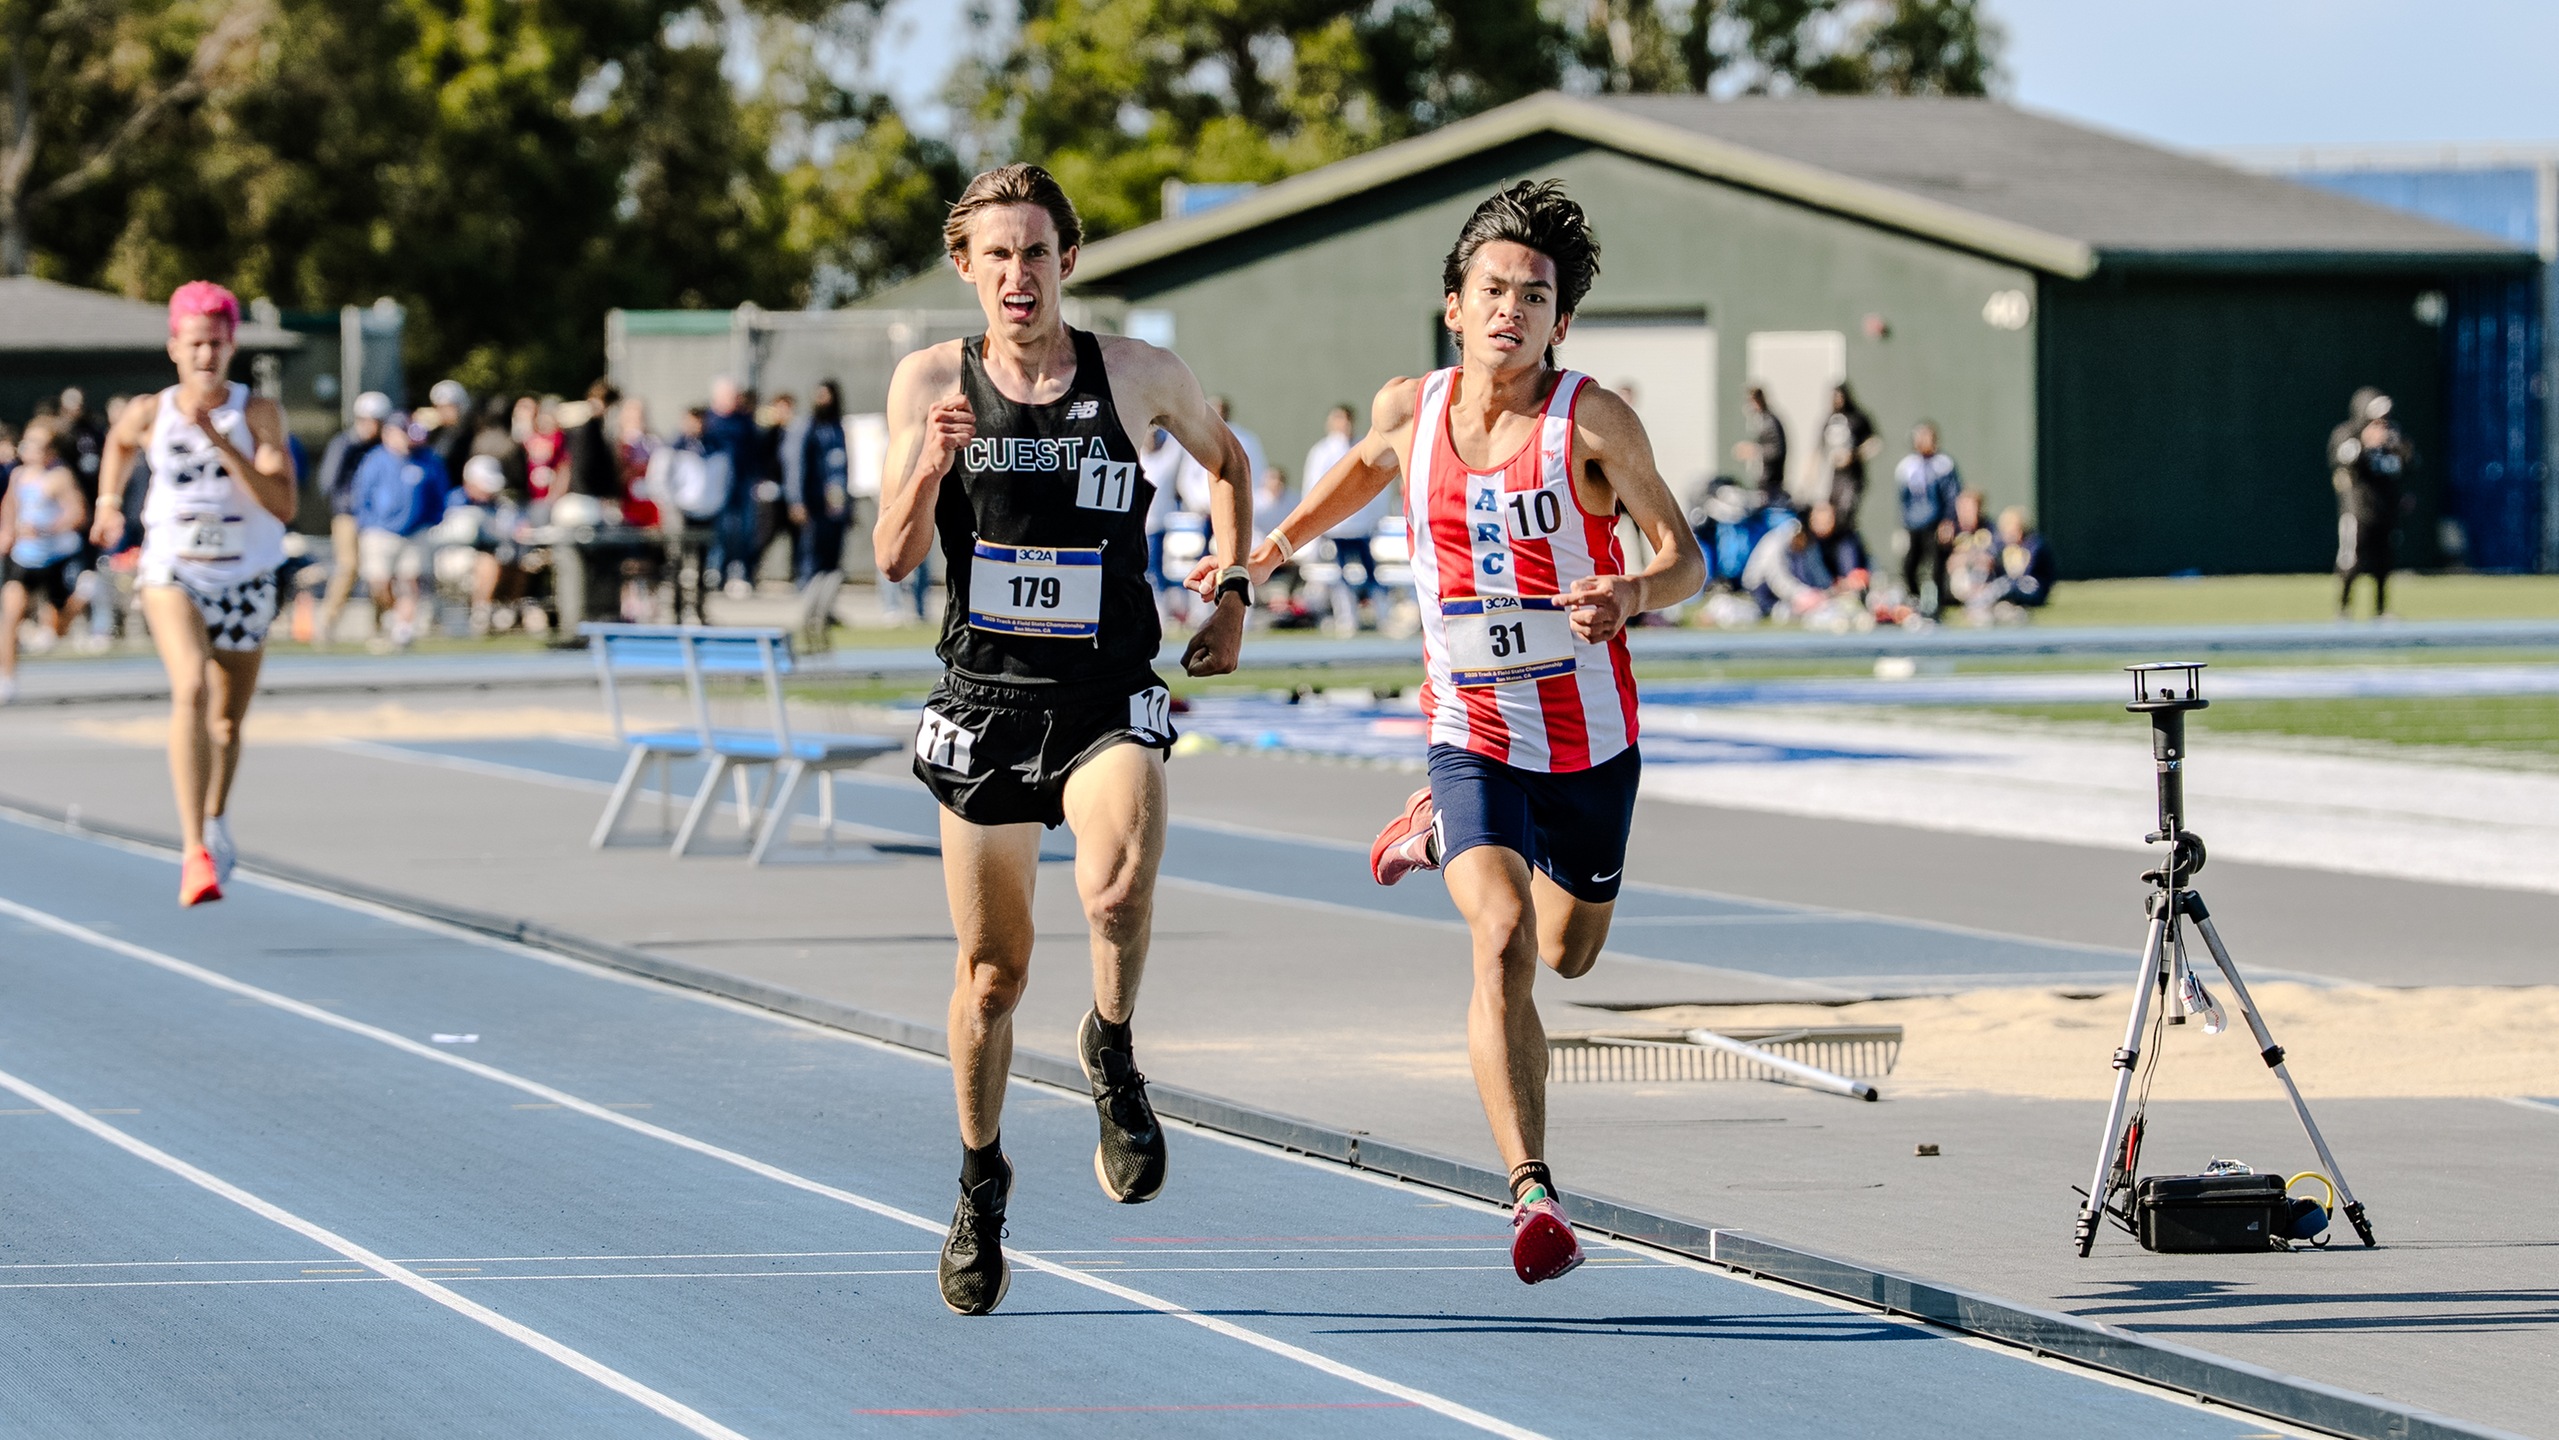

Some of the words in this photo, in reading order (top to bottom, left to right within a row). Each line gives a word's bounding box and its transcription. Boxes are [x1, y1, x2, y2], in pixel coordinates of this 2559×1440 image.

[964, 436, 1110, 472] CUESTA
[1092, 464, 1128, 510] 11
[1474, 488, 1504, 575] ARC
[1508, 490, 1562, 537] 10
[1019, 549, 1053, 562] 3C2A
[1008, 576, 1061, 609] 179
[1485, 597, 1518, 609] 3C2A
[1489, 621, 1527, 658] 31
[1526, 662, 1563, 672] Championship
[1140, 689, 1167, 732] 11
[927, 719, 960, 767] 11
